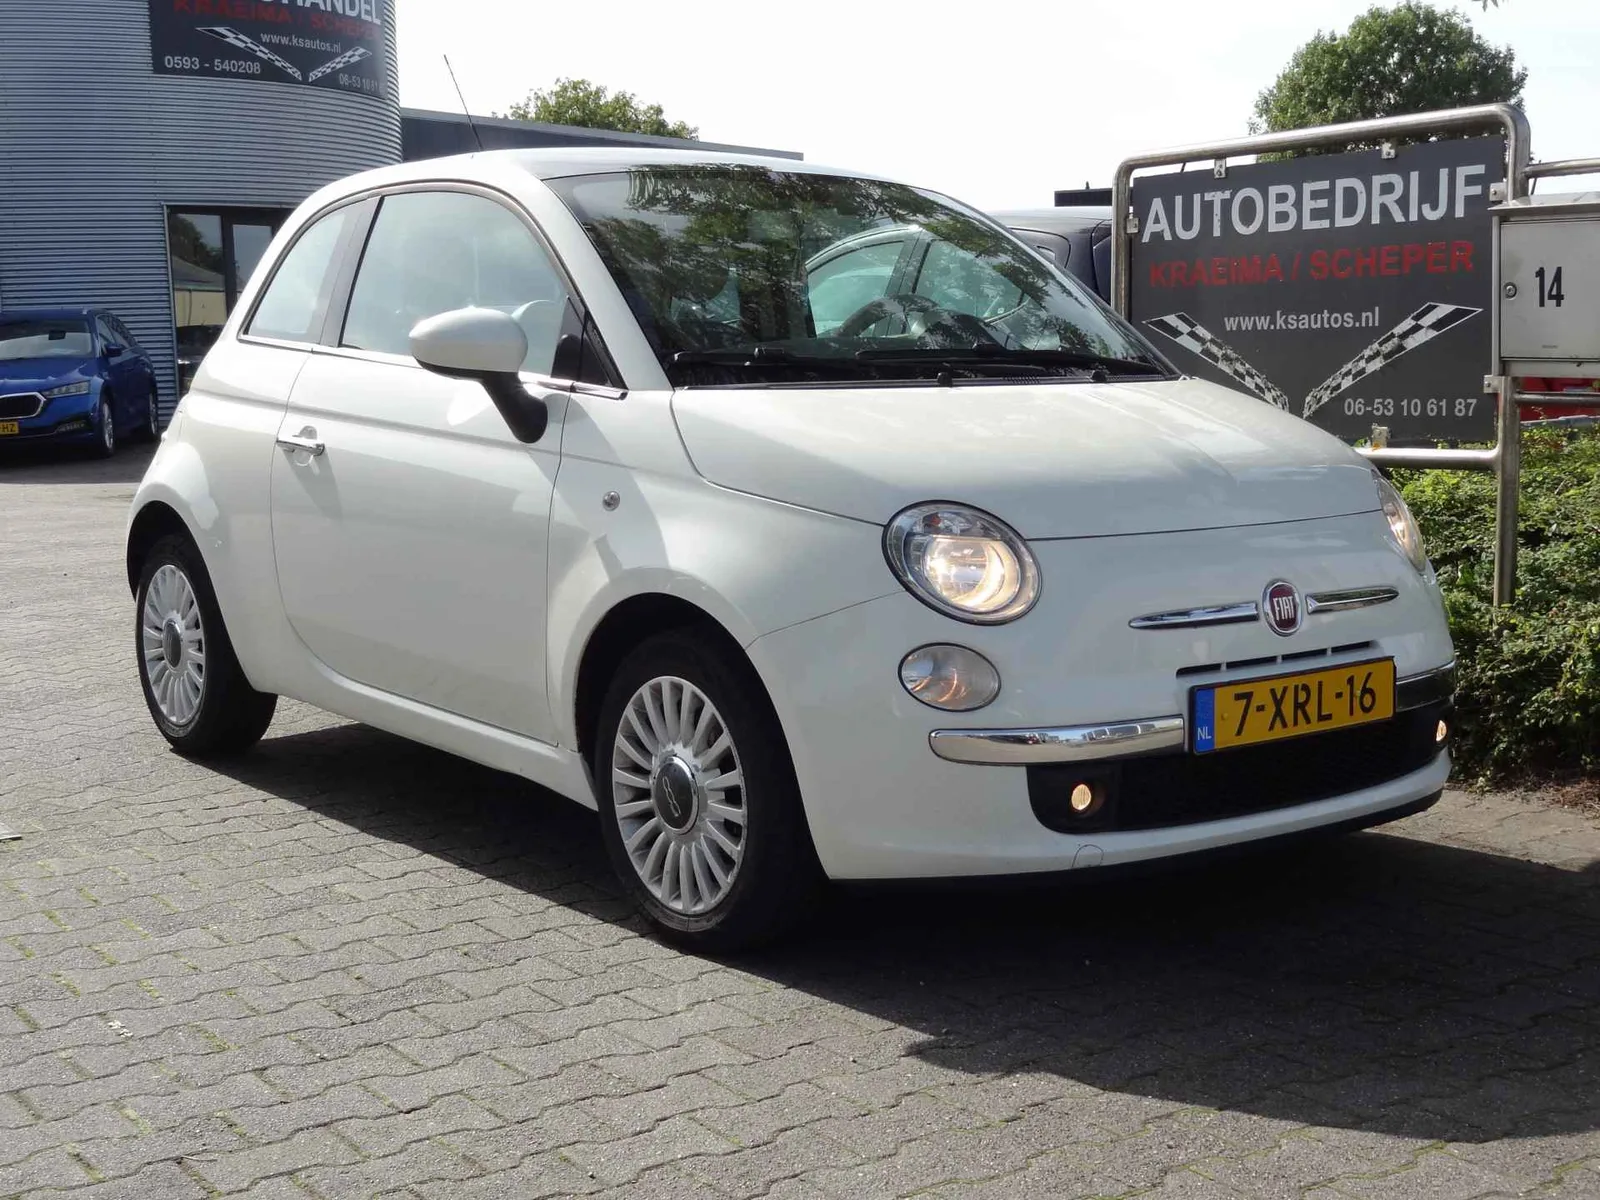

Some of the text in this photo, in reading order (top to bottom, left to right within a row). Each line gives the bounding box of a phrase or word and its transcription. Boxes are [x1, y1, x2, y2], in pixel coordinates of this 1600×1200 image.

[260, 32, 342, 54] www.ksautos.nl
[164, 55, 200, 70] 0593
[214, 58, 261, 74] 540208
[1141, 164, 1486, 243] AUTOBEDRIJF
[1150, 254, 1285, 287] KRAEIMA
[1310, 241, 1474, 279] SCHEPER
[1535, 266, 1565, 308] 14
[1223, 307, 1380, 332] www.ksautos.nl
[1344, 399, 1477, 417] 06-53 10 61 87
[1273, 595, 1295, 621] FIAT
[1233, 671, 1376, 737] 7-XRL-16
[1197, 726, 1213, 741] NL
